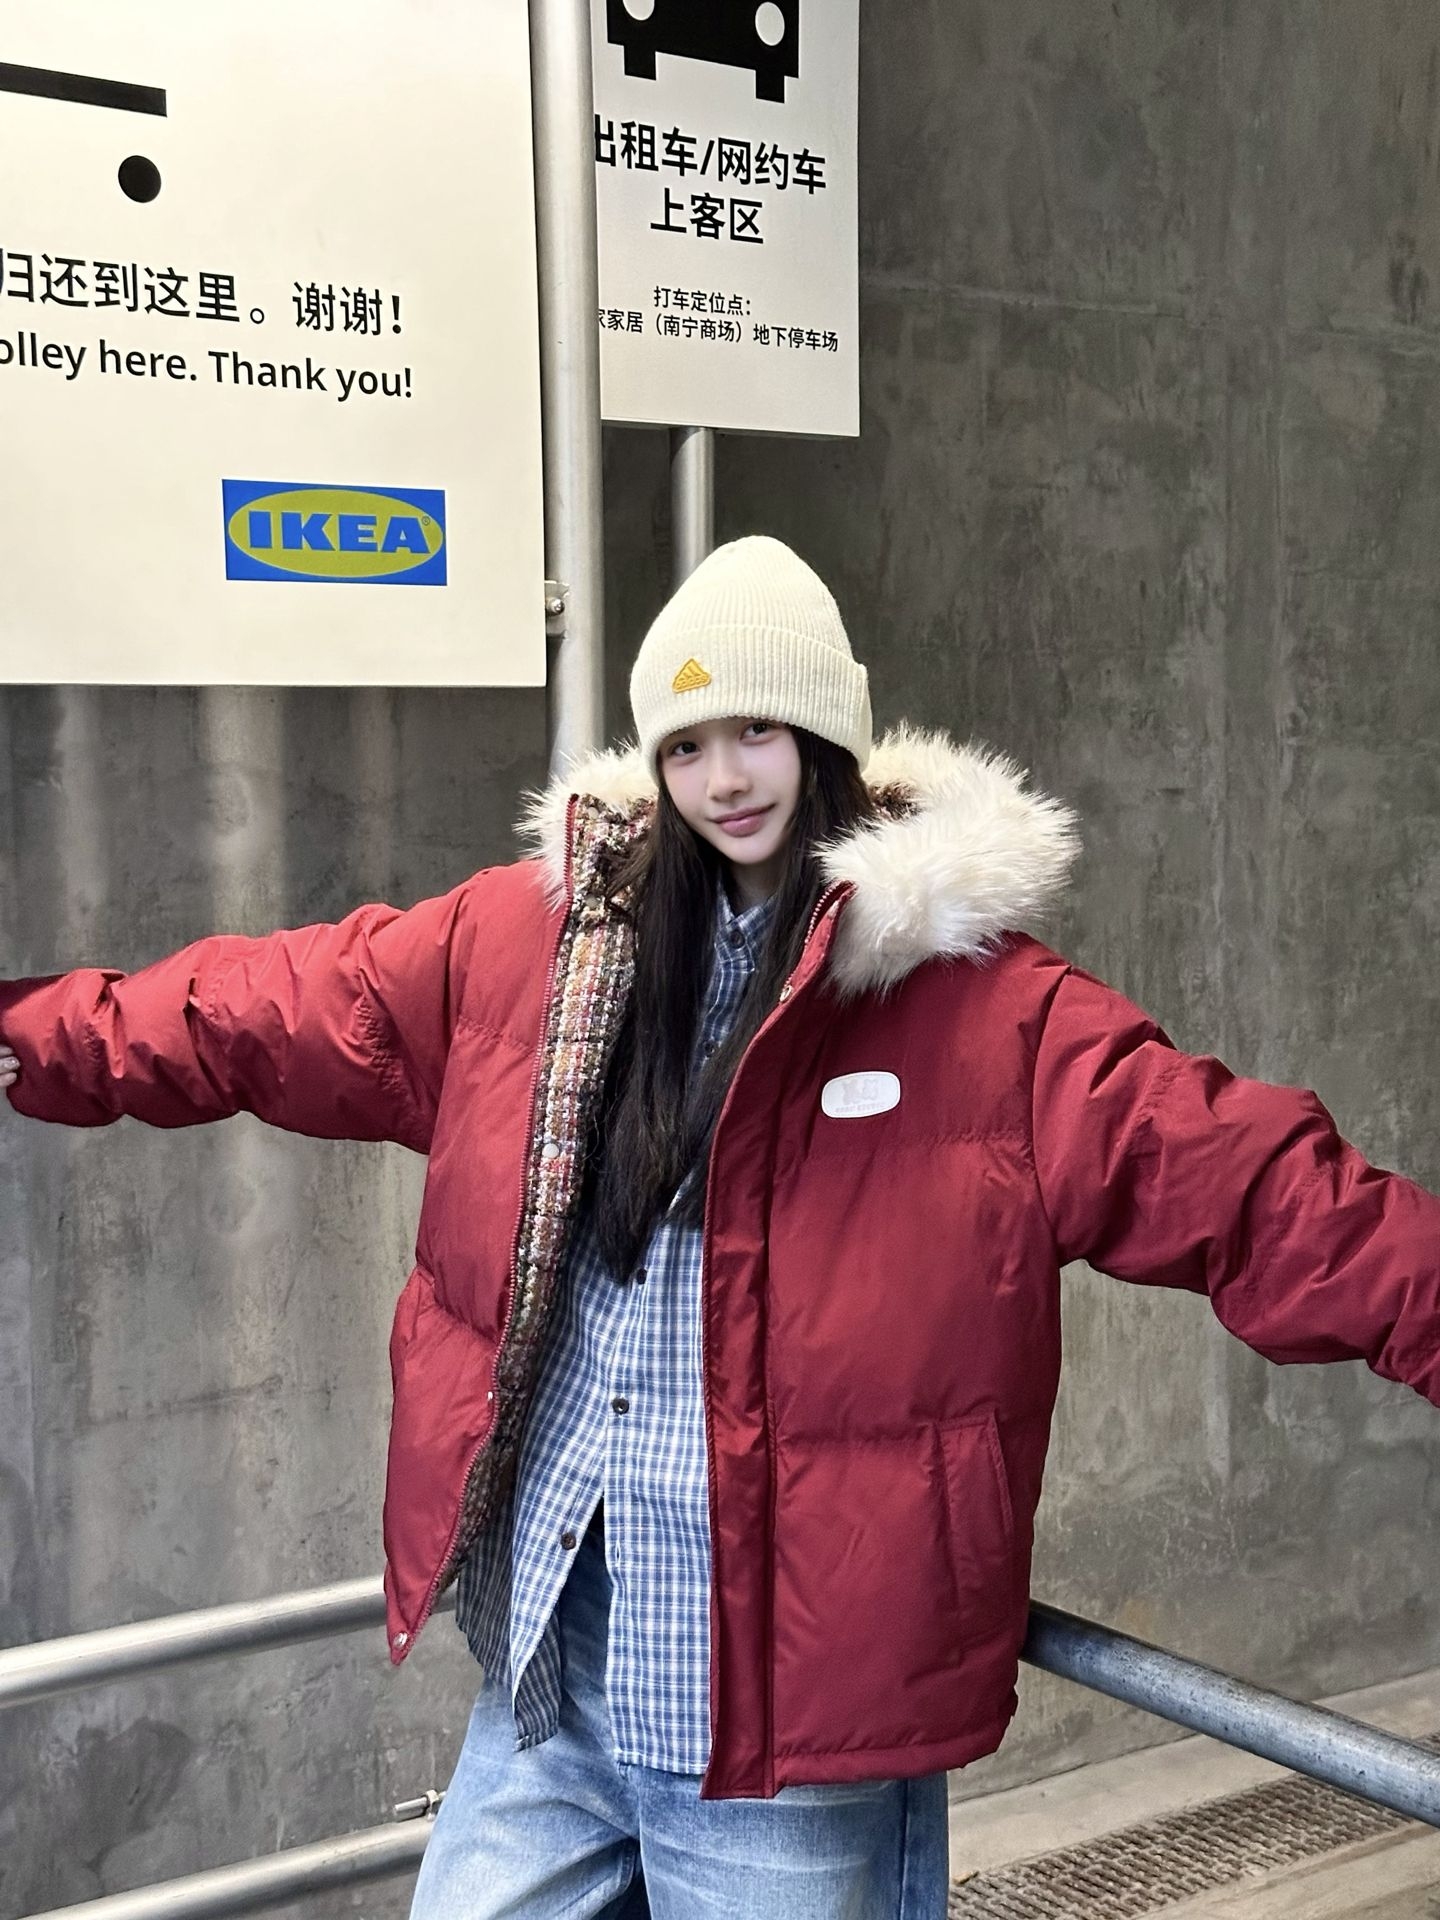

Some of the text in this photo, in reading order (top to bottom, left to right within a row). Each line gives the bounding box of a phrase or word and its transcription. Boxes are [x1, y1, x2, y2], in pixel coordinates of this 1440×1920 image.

[650, 187, 764, 245] 上客区
[653, 285, 751, 317] 打车定位点：
[99, 338, 198, 382] here.
[207, 350, 328, 392] Thank
[335, 367, 412, 402] you!
[248, 510, 431, 554] IKEA
